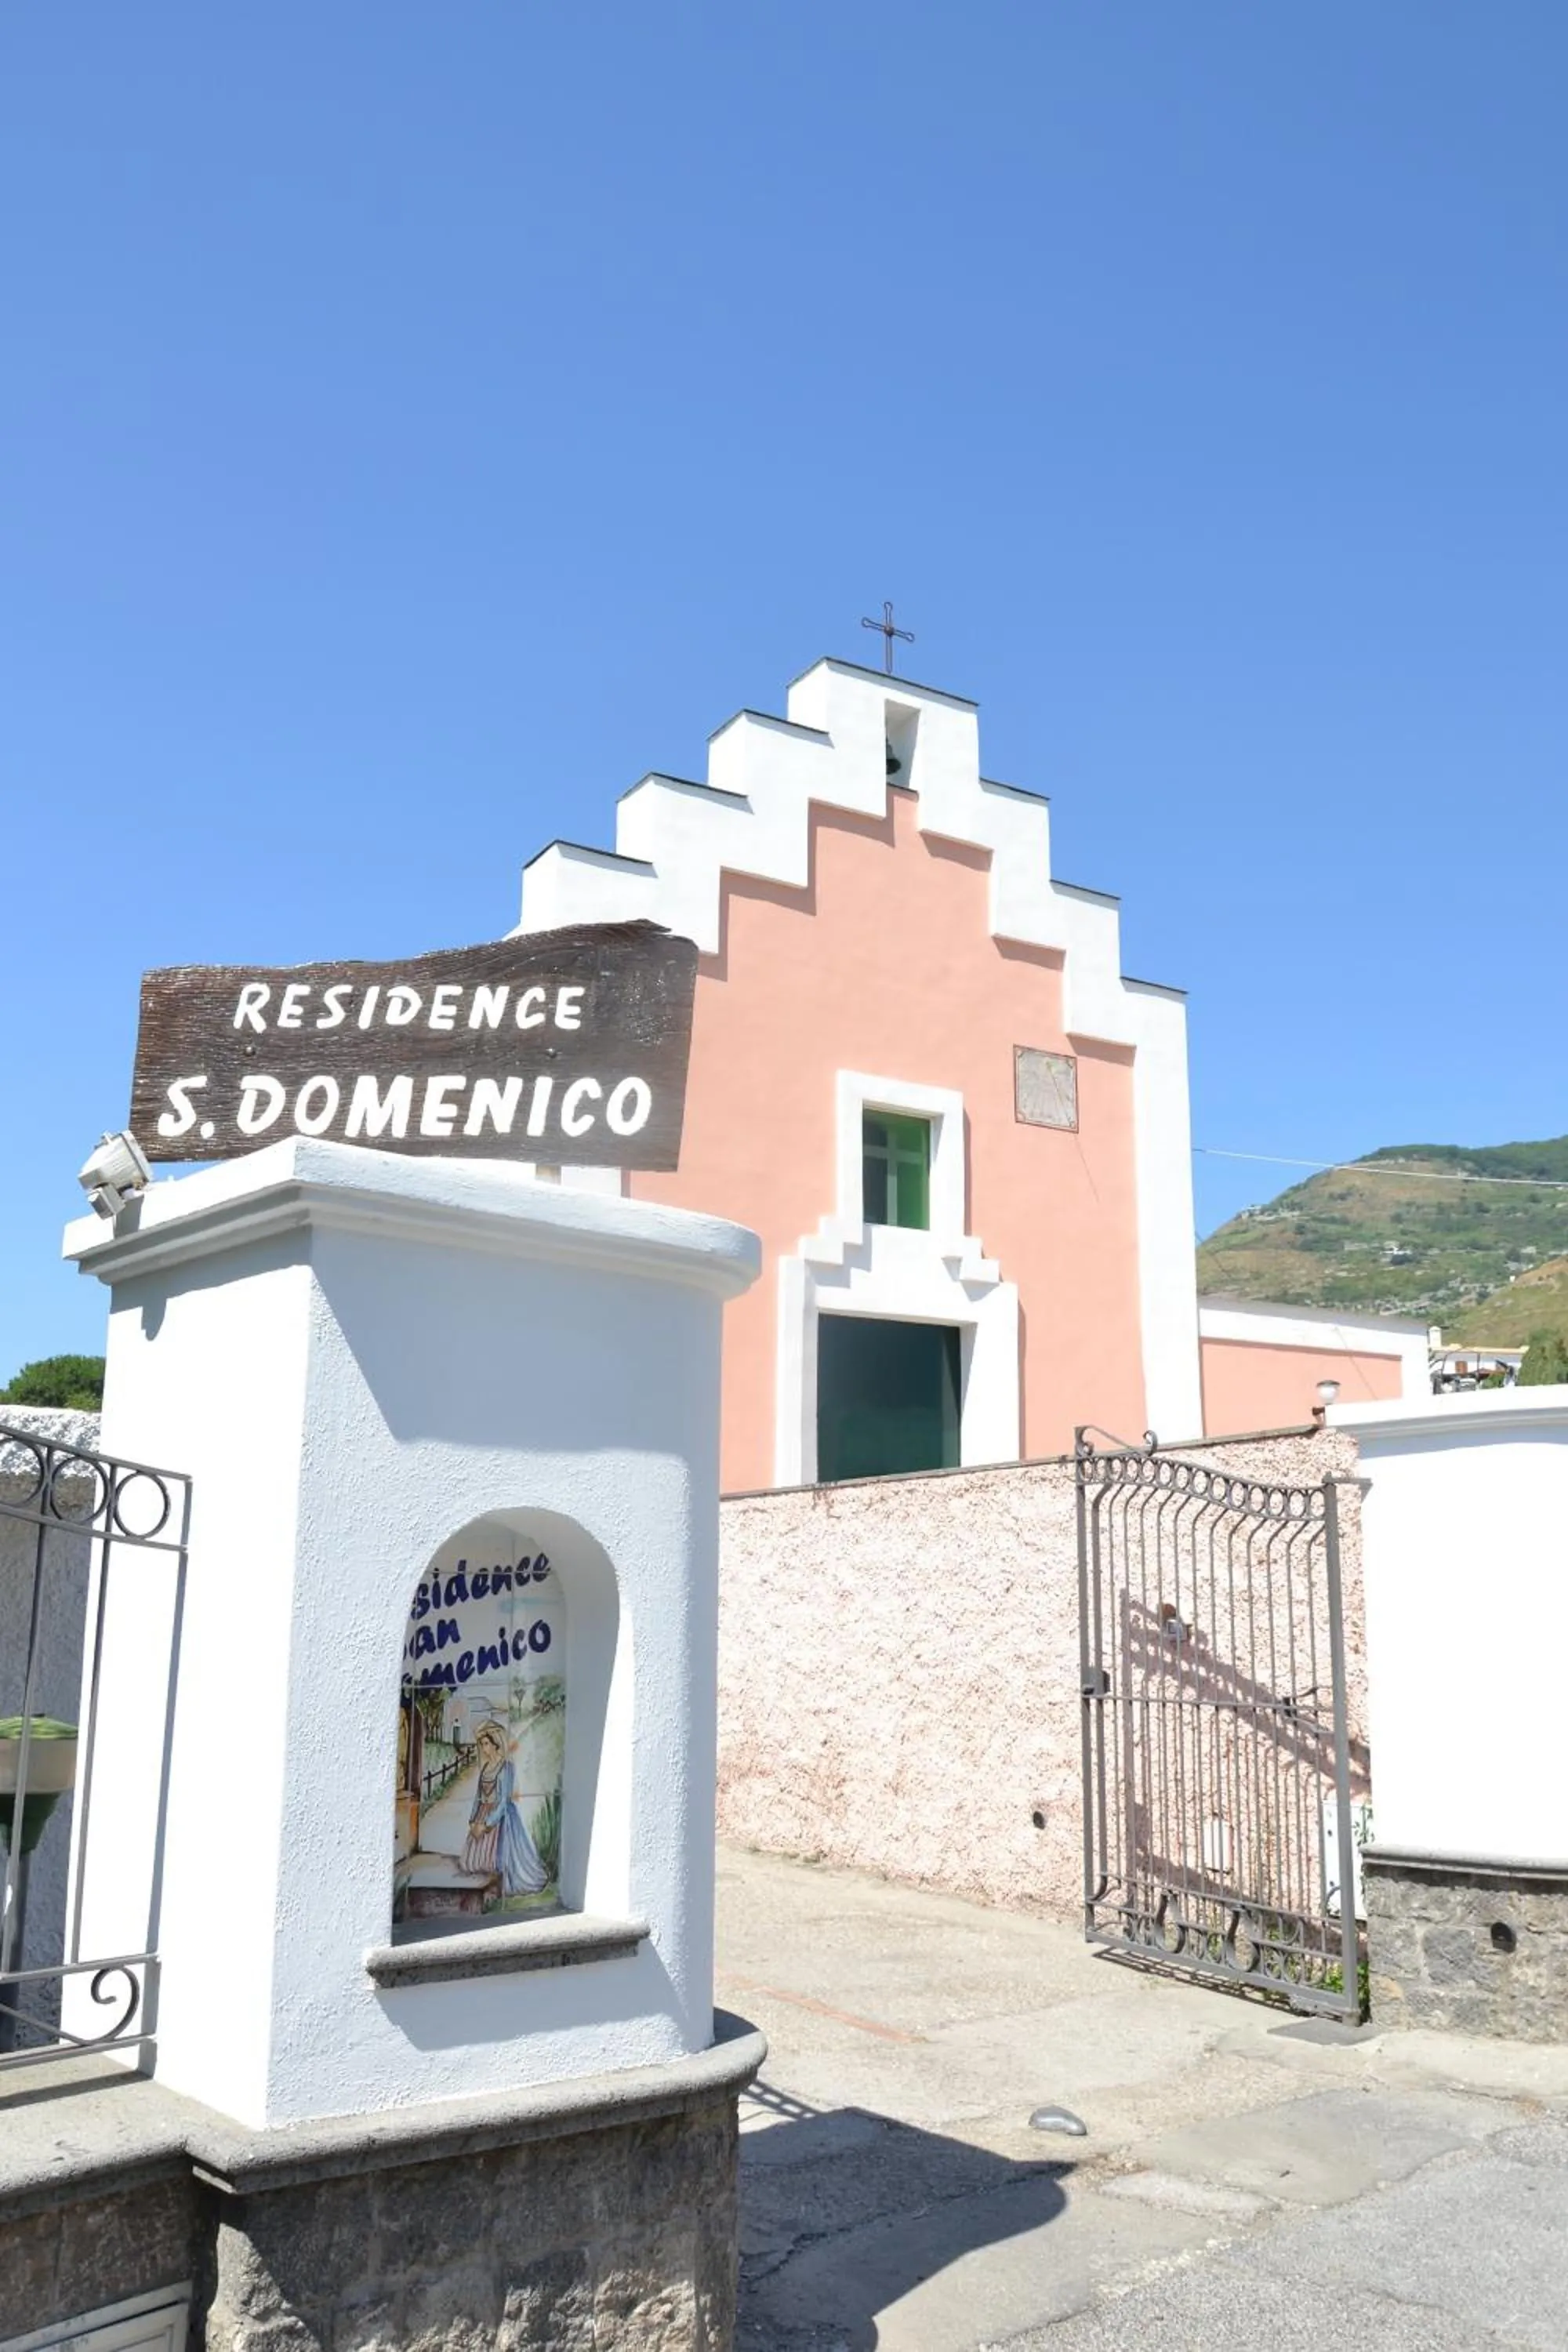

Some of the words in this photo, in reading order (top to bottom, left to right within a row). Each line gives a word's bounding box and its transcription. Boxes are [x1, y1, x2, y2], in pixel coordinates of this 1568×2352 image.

[233, 982, 585, 1033] RESIDENCE
[156, 1075, 216, 1140] S.
[236, 1075, 652, 1139] DOMENICO
[402, 1618, 461, 1661] an
